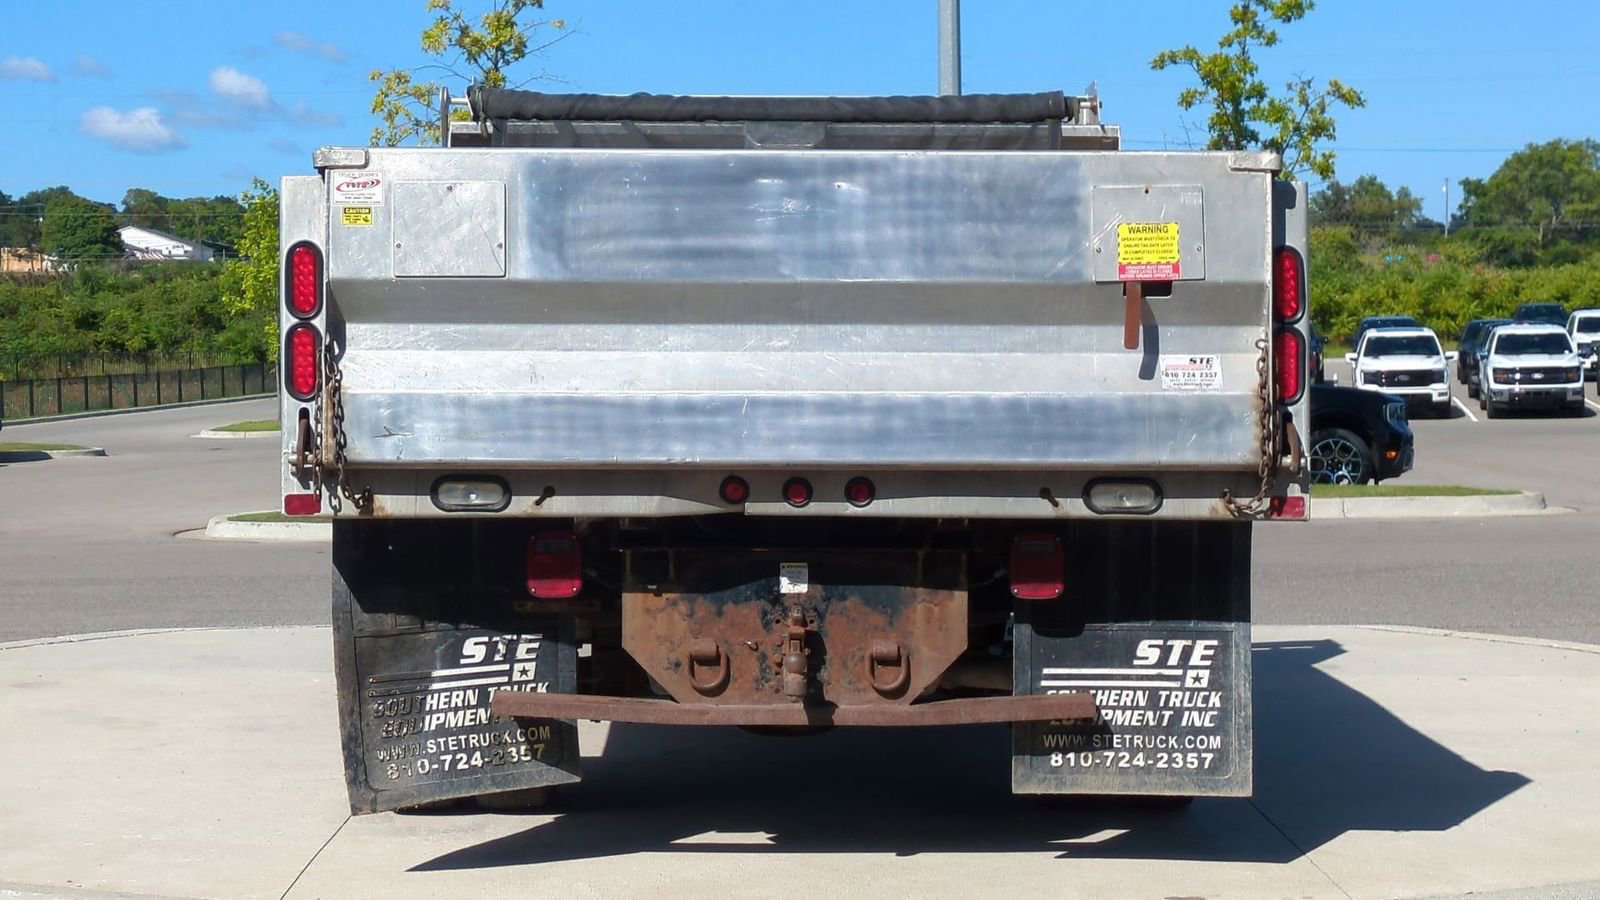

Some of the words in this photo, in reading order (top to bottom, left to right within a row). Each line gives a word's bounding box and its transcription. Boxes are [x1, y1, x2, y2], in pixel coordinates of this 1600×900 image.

[1128, 226, 1168, 234] WARNING
[460, 634, 543, 664] STE
[1133, 640, 1218, 666] STE
[373, 687, 480, 718] SOUTHERN
[1047, 690, 1149, 707] HERN
[1158, 691, 1222, 708] TRUCK
[382, 707, 492, 739] EQUIPMEN
[1181, 710, 1218, 727] INC
[377, 725, 550, 761] WWW.STETRUCK.COM
[1043, 734, 1221, 750] WWWSTETRUCK.COM
[386, 743, 545, 780] 810-724-2357
[1050, 752, 1214, 769] 810-724-2357
